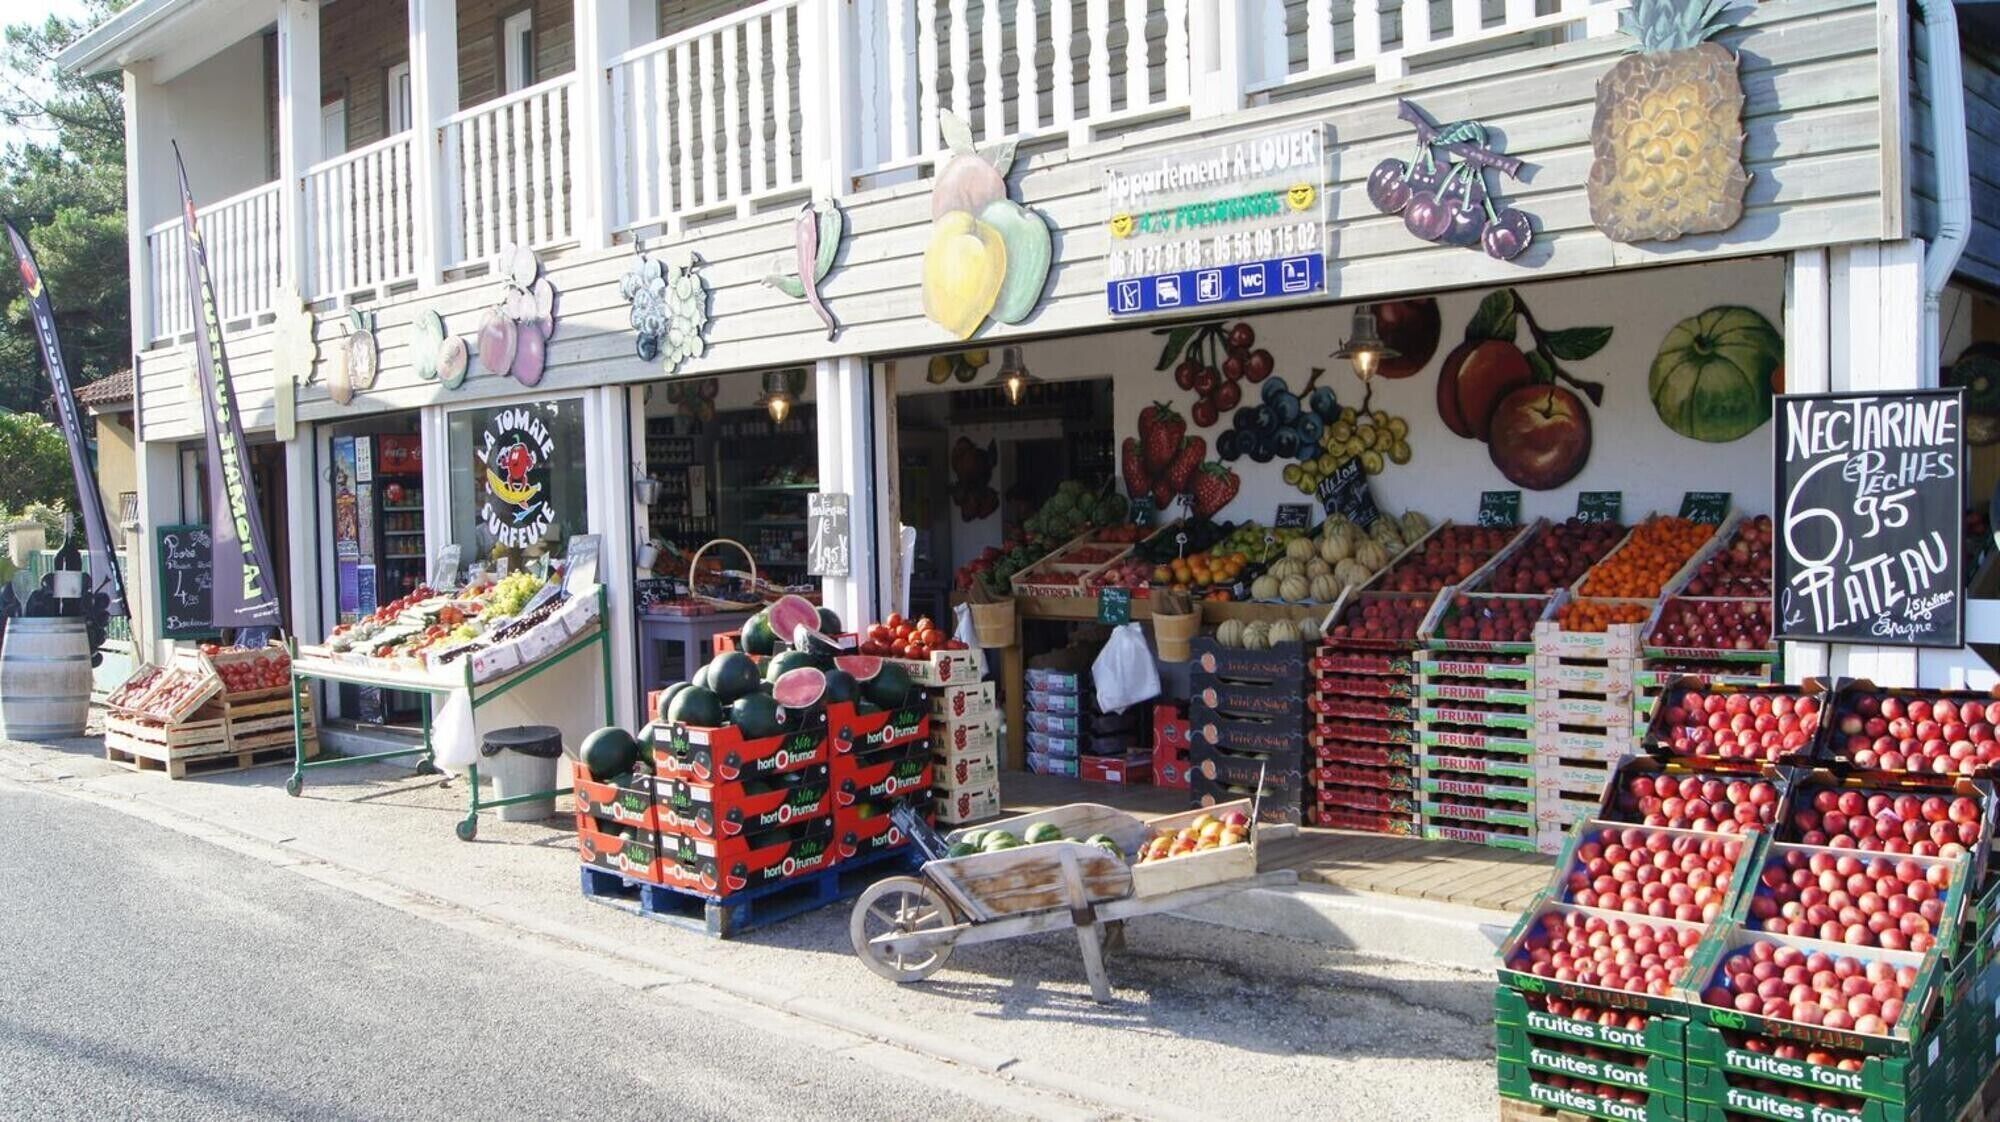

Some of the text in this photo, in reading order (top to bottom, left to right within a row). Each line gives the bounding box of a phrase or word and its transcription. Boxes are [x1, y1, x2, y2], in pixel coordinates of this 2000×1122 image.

[1107, 147, 1229, 206] Appartement
[1250, 131, 1316, 173] LOUER
[1109, 252, 1126, 276] 06
[1129, 250, 1144, 275] 70
[1149, 246, 1162, 271] 27
[1165, 243, 1181, 268] 97
[1185, 240, 1201, 265] 83
[1214, 235, 1231, 260] 05
[1234, 232, 1251, 258] 56
[1256, 229, 1272, 255] 09
[1277, 226, 1294, 252] 15
[1298, 222, 1317, 250] 02
[1242, 273, 1263, 287] WC
[478, 408, 555, 464] LA TOMATE
[1785, 396, 1959, 462] NECTARINE
[481, 501, 555, 549] SURFEUSE
[1791, 531, 1949, 634] PLATEAU
[1438, 663, 1485, 675] IFRUMI
[1438, 687, 1485, 699] IFRUMI
[1437, 710, 1484, 723] IFRUMI
[1438, 733, 1485, 748] IFRUMI
[1438, 757, 1485, 771] IFRUMI
[1438, 781, 1485, 795] IFRUMI
[1438, 805, 1485, 819] IFRUMI
[1440, 828, 1486, 843] IFRUMI
[1527, 1011, 1645, 1047] fruites font
[1530, 1048, 1648, 1086] fruites font
[1726, 1050, 1862, 1090] fruites font
[1529, 1083, 1647, 1122] fruites font
[1727, 1090, 1862, 1122] fruites font
